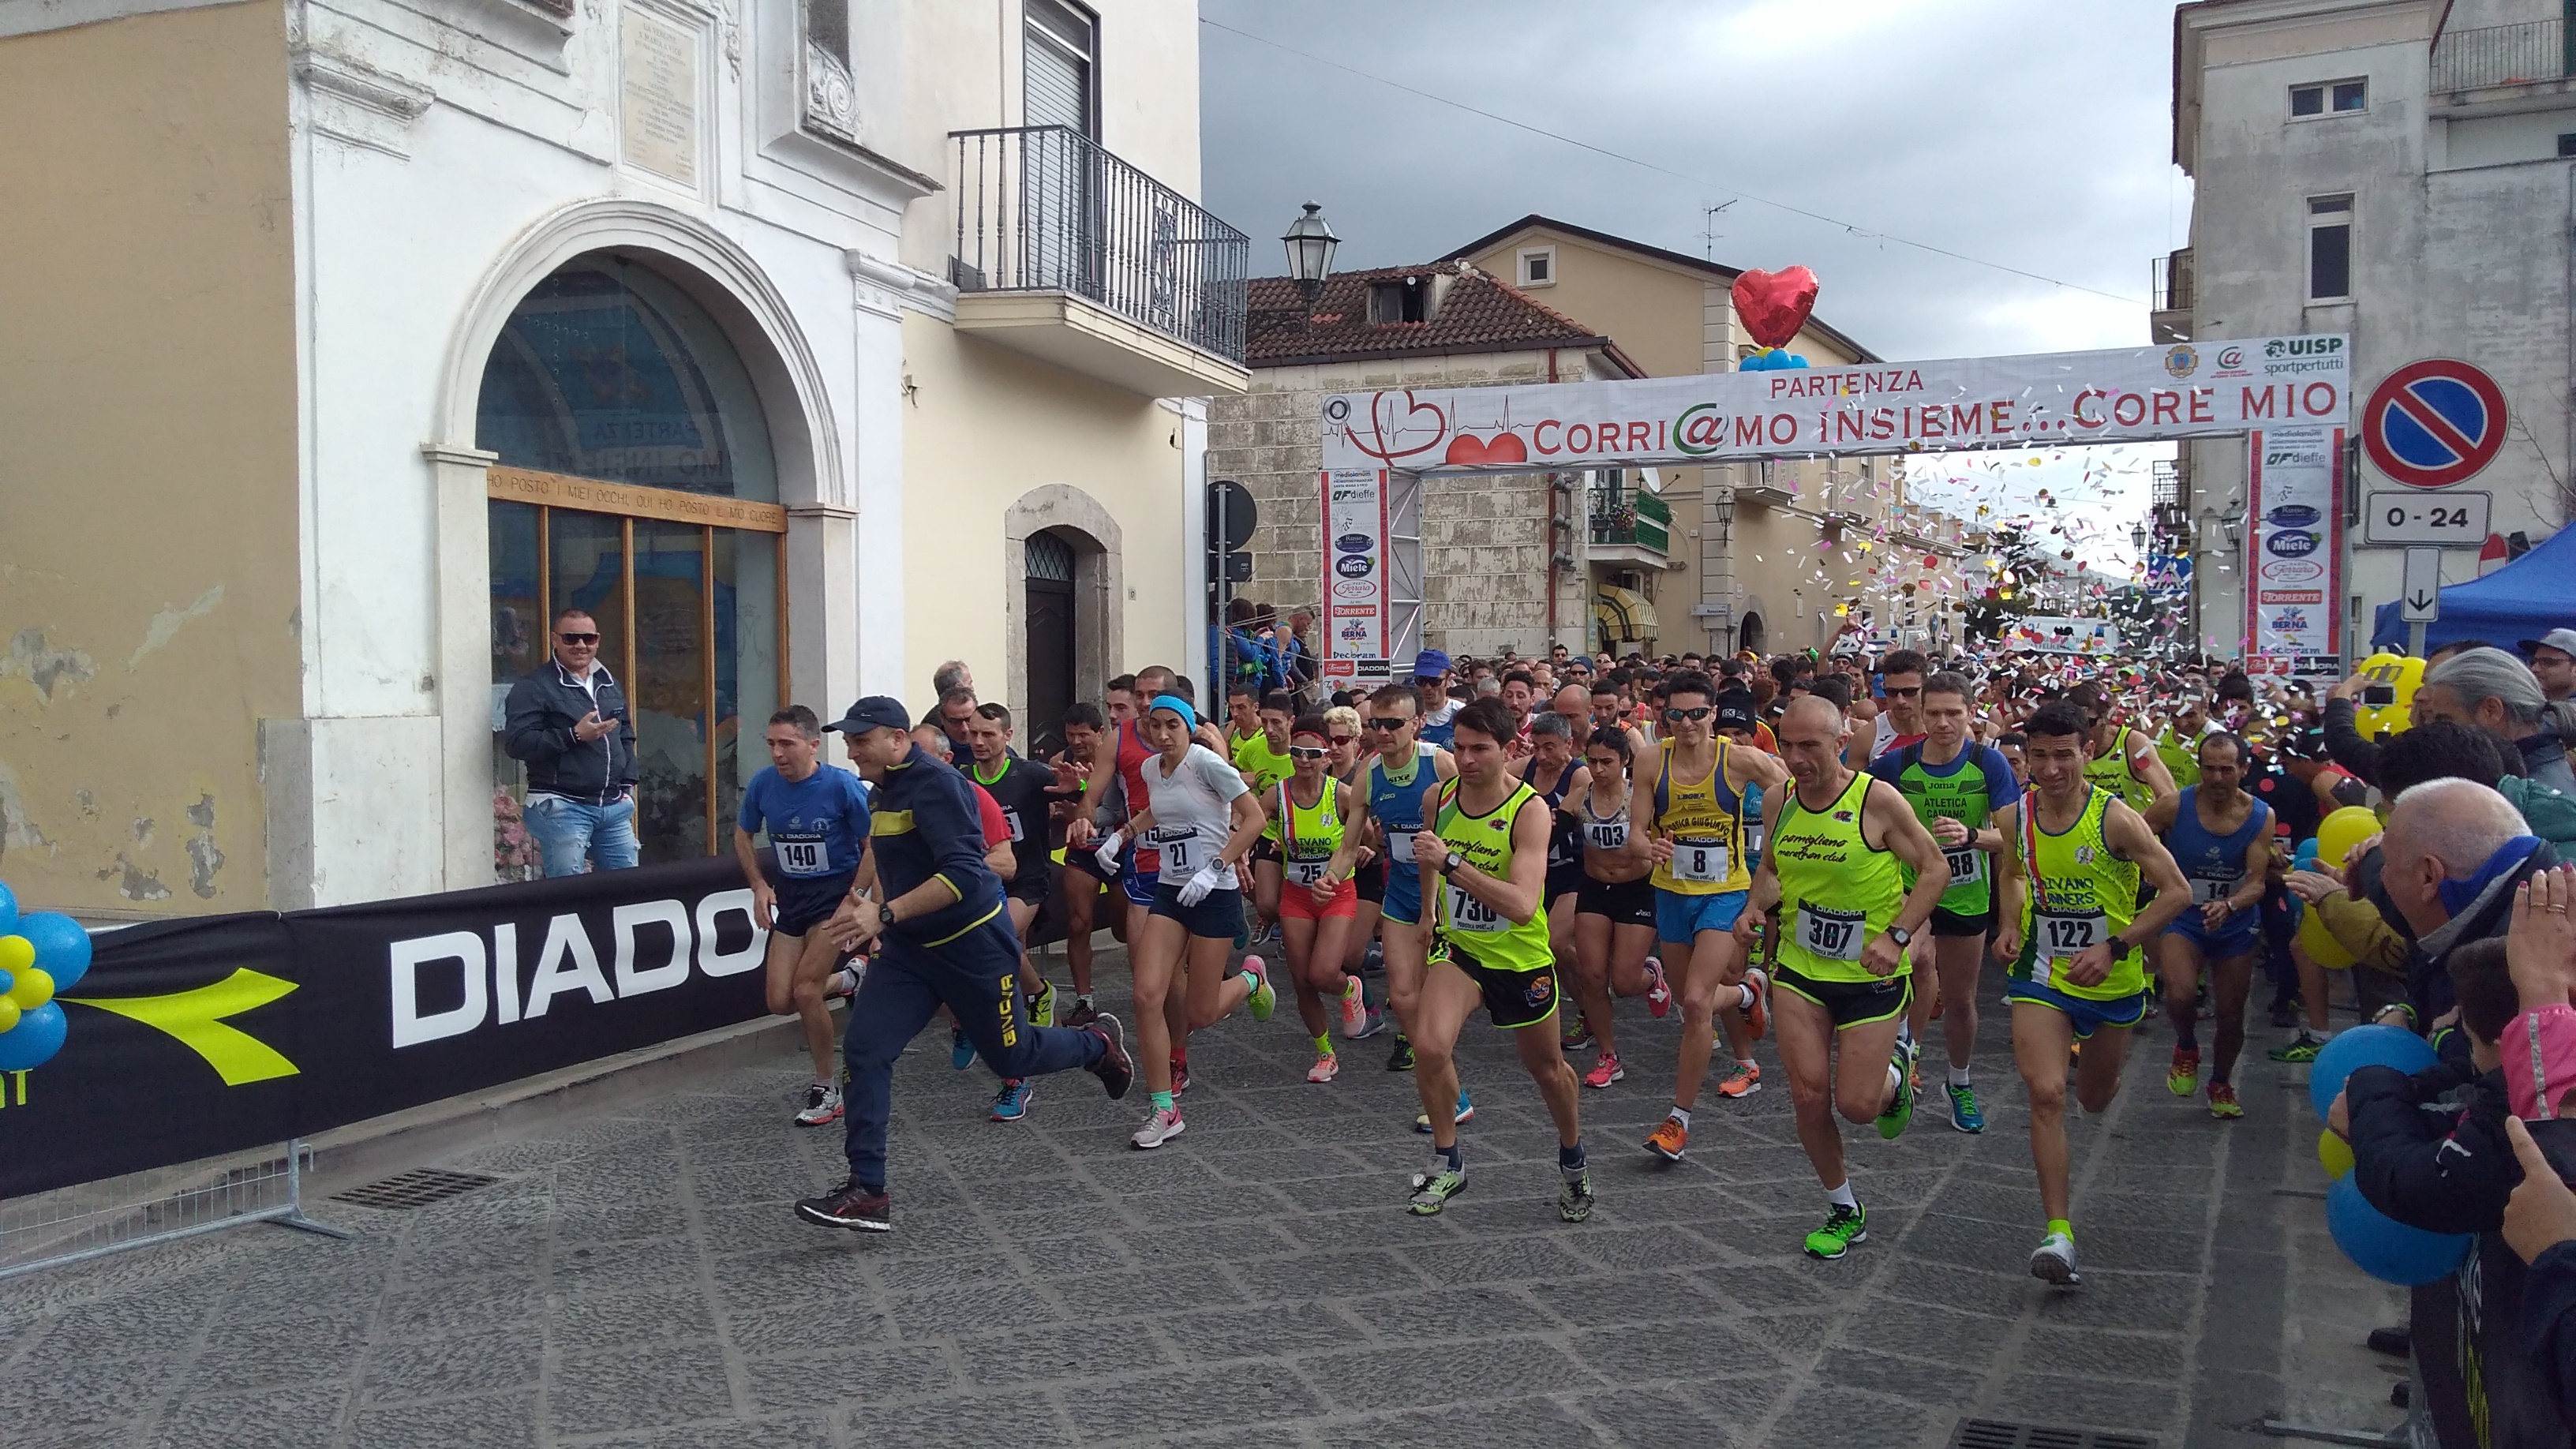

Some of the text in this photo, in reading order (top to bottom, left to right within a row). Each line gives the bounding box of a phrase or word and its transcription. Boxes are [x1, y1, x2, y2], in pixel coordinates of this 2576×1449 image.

[2290, 338, 2343, 355] UISP
[2264, 357, 2343, 376] sportpertutti
[1771, 369, 1924, 399] PARTENZA
[2241, 381, 2337, 420] MIO
[2293, 451, 2326, 463] dieffe
[511, 477, 549, 494] POSTO
[567, 485, 590, 500] MIEI
[597, 489, 630, 507] OCCHI,
[636, 495, 653, 508] QUI
[659, 499, 672, 511] HO
[680, 500, 710, 515] POSTO
[729, 507, 744, 520] MIO
[750, 509, 777, 524] CUORE
[1350, 489, 1375, 500] dieffe
[2430, 507, 2469, 528] 24
[2273, 538, 2312, 551] Miele
[1341, 563, 1368, 572] Miele
[1339, 584, 1370, 593] Ferrara
[2272, 620, 2308, 630] BERNA
[1923, 797, 1968, 807] ATLETICA
[1926, 809, 1966, 819] CAIVANO
[1691, 818, 1730, 836] GIUGLIANO
[1592, 826, 1624, 847] 403
[784, 844, 816, 866] 140
[1169, 842, 1187, 867] 27
[1694, 850, 1705, 873] 8
[1822, 852, 1847, 863] club
[1301, 865, 1322, 884] 25
[2207, 882, 2230, 900] 14
[1816, 905, 1863, 916] DIADORA
[1808, 915, 1854, 951] 307
[2047, 920, 2095, 948] 122
